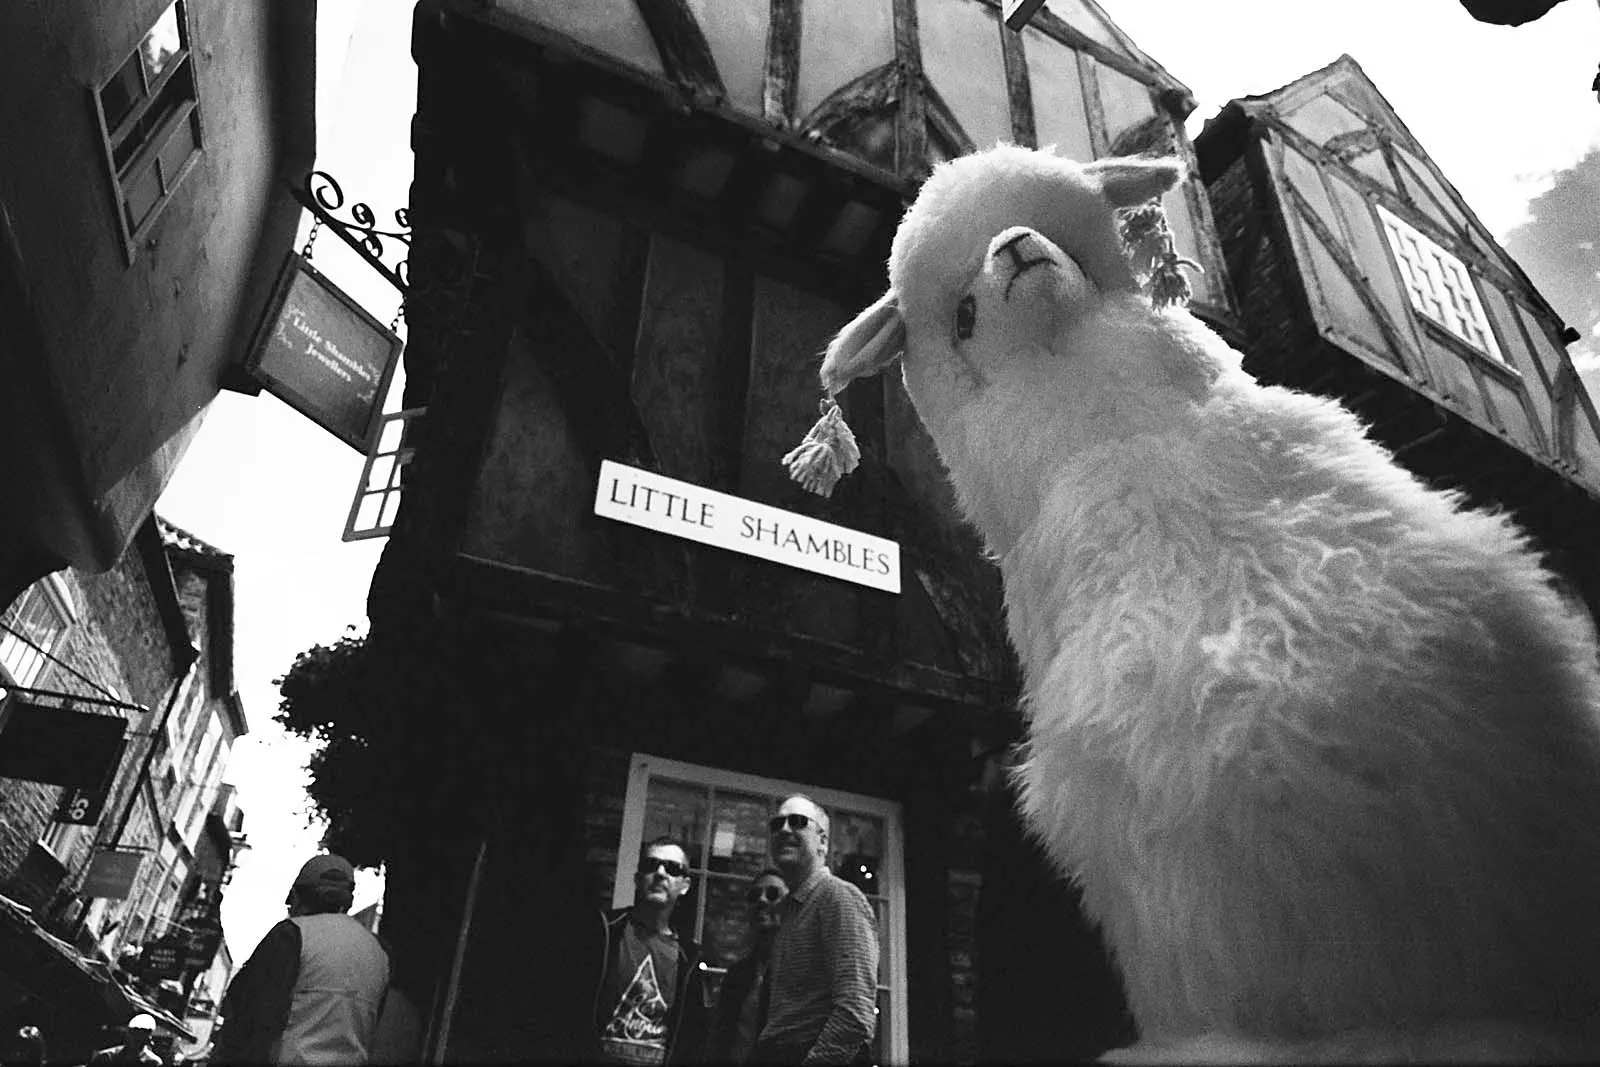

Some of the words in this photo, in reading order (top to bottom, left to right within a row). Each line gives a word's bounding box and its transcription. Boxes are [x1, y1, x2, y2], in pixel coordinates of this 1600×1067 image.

[304, 342, 351, 382] Jewellers
[609, 478, 715, 529] LITTLE
[740, 515, 890, 575] SHAMBLES
